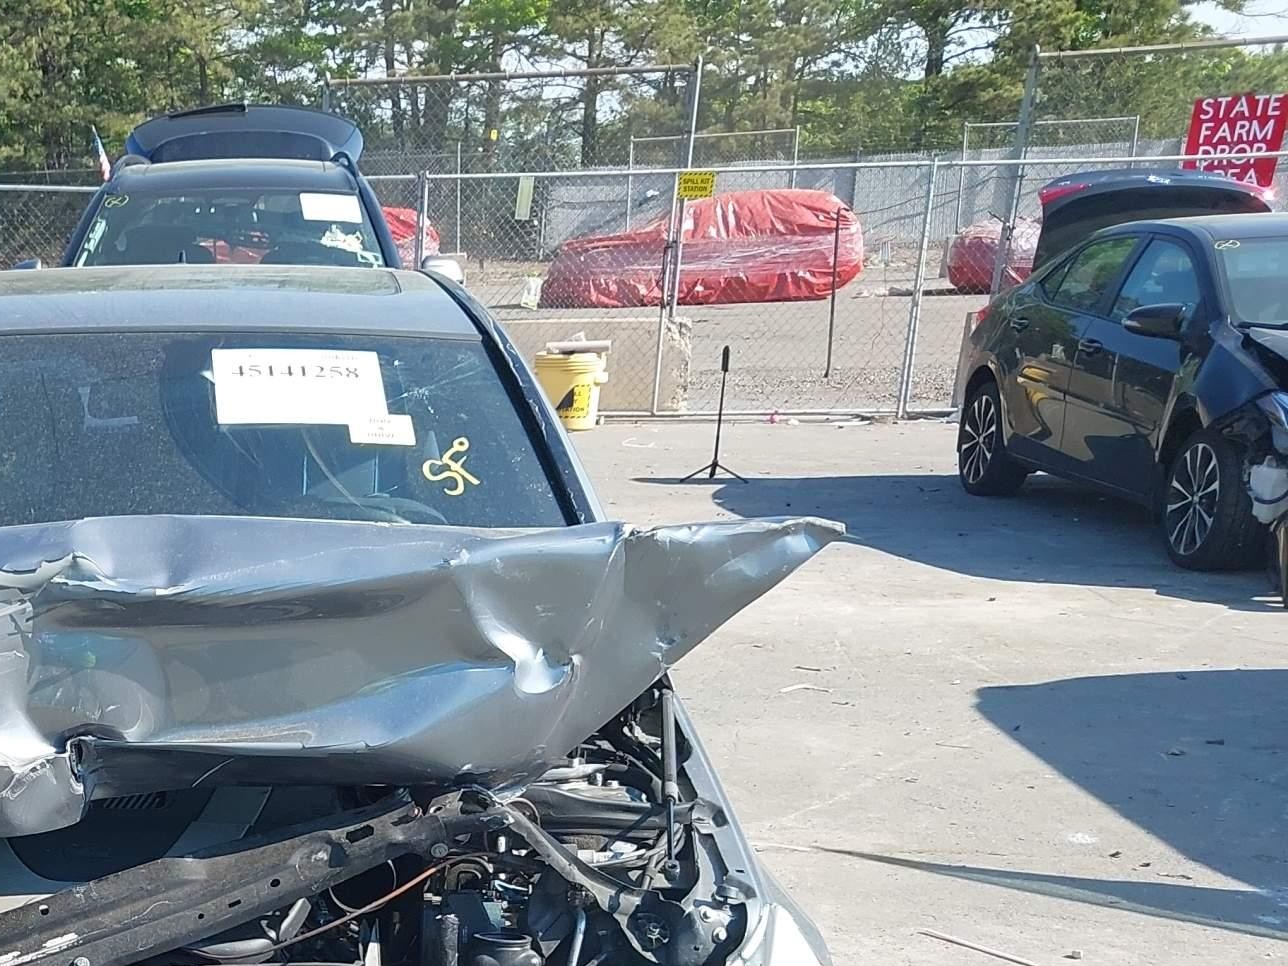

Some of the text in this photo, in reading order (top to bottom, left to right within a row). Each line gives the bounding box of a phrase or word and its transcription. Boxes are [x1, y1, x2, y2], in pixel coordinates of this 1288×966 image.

[1199, 94, 1285, 119] STATE
[1198, 119, 1275, 144] FARM
[1196, 143, 1267, 167] DROP
[231, 364, 360, 379] 45141258
